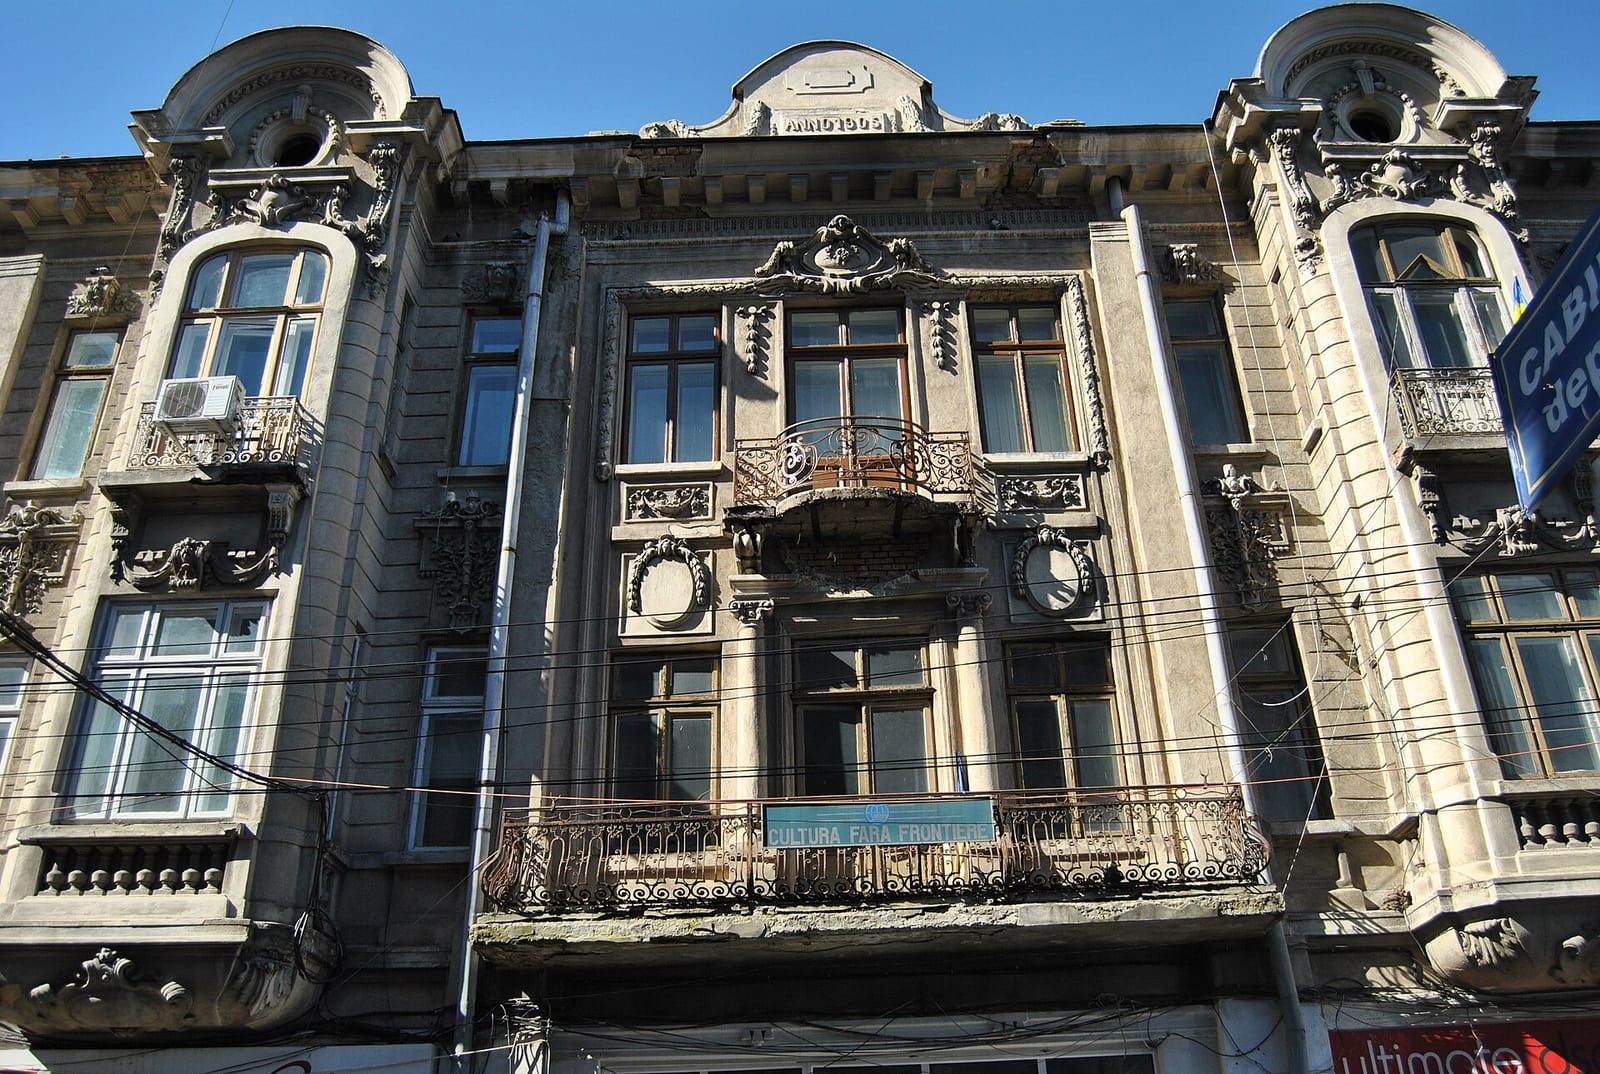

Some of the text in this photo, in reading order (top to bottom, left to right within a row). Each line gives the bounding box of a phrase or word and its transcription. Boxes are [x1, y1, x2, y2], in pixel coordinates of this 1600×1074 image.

[785, 117, 834, 133] ANNO
[1518, 252, 1600, 396] CABI
[768, 822, 989, 846] CULTURA FARA FRONTIERE
